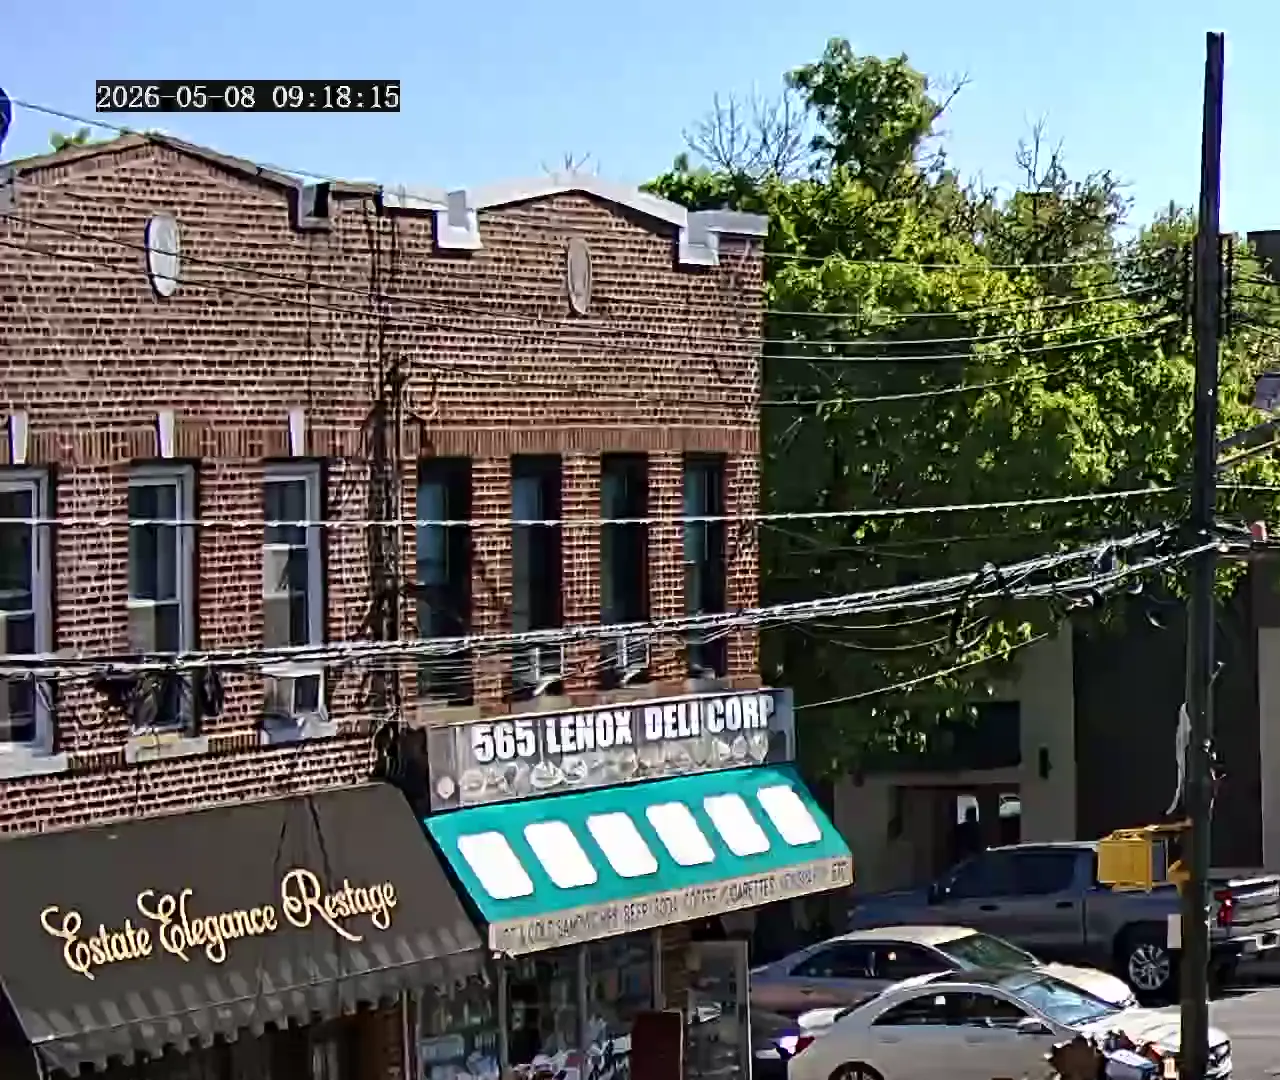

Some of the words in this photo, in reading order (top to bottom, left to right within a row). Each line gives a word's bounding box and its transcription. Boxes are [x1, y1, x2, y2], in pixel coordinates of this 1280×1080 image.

[471, 719, 536, 762] 565
[546, 710, 633, 754] LENOX
[644, 701, 700, 740] DELI
[707, 695, 775, 733] CORP
[41, 906, 153, 980] Estate
[138, 888, 278, 964] Elegance
[281, 868, 397, 942] Restage
